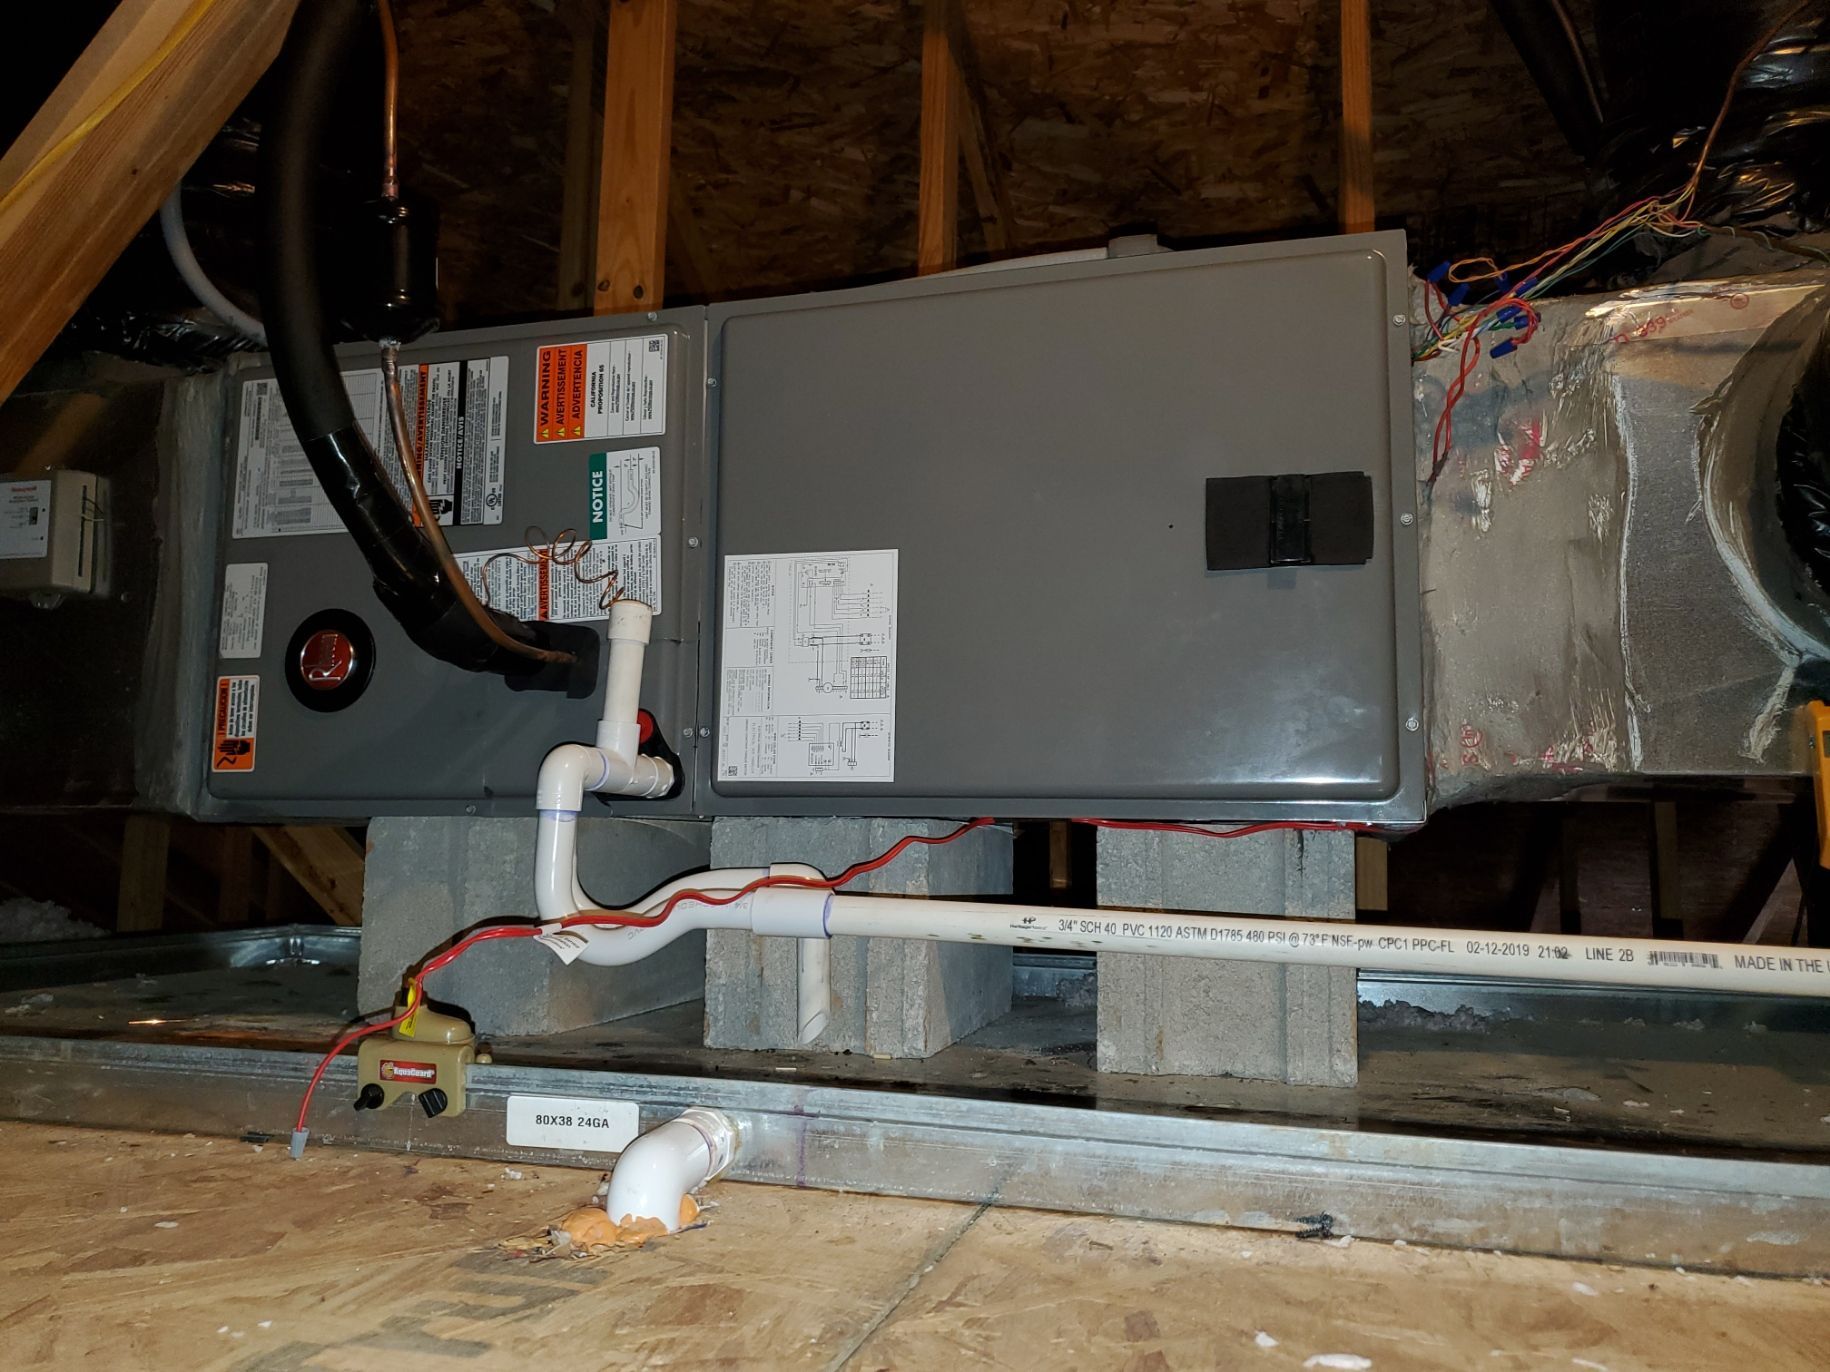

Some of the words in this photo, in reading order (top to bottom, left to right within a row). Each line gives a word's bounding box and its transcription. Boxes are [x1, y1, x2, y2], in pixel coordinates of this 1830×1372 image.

[540, 351, 551, 425] WARNING
[556, 349, 567, 425] AVERTISSEMENT
[572, 350, 583, 419] ADVERTENCIA
[599, 364, 605, 372] 65
[456, 416, 465, 469] NOTICE/AVIS
[592, 470, 604, 523] NOTICE
[1058, 919, 1078, 932] 3/4"
[1080, 920, 1101, 933] SCH
[1104, 922, 1117, 935] 40
[1122, 923, 1145, 936] PVC
[1148, 924, 1172, 938] 1120
[1175, 925, 1207, 940] ASTM
[1210, 928, 1243, 942] D1785
[1245, 929, 1264, 942] 480
[1268, 931, 1286, 944] PSI
[1288, 932, 1300, 948] @
[1331, 934, 1373, 951] NSF-pw
[1378, 936, 1408, 950] CPC1
[1412, 938, 1455, 953] PPC-FL
[1466, 940, 1530, 957] 02-12-2019
[1585, 947, 1614, 961] LINE
[1619, 948, 1634, 962] 2B
[1734, 954, 1776, 971] MADE
[1779, 957, 1792, 972] IN
[1795, 958, 1823, 973] THE
[535, 1114, 573, 1126] 80X38
[577, 1116, 610, 1129] 24GA
